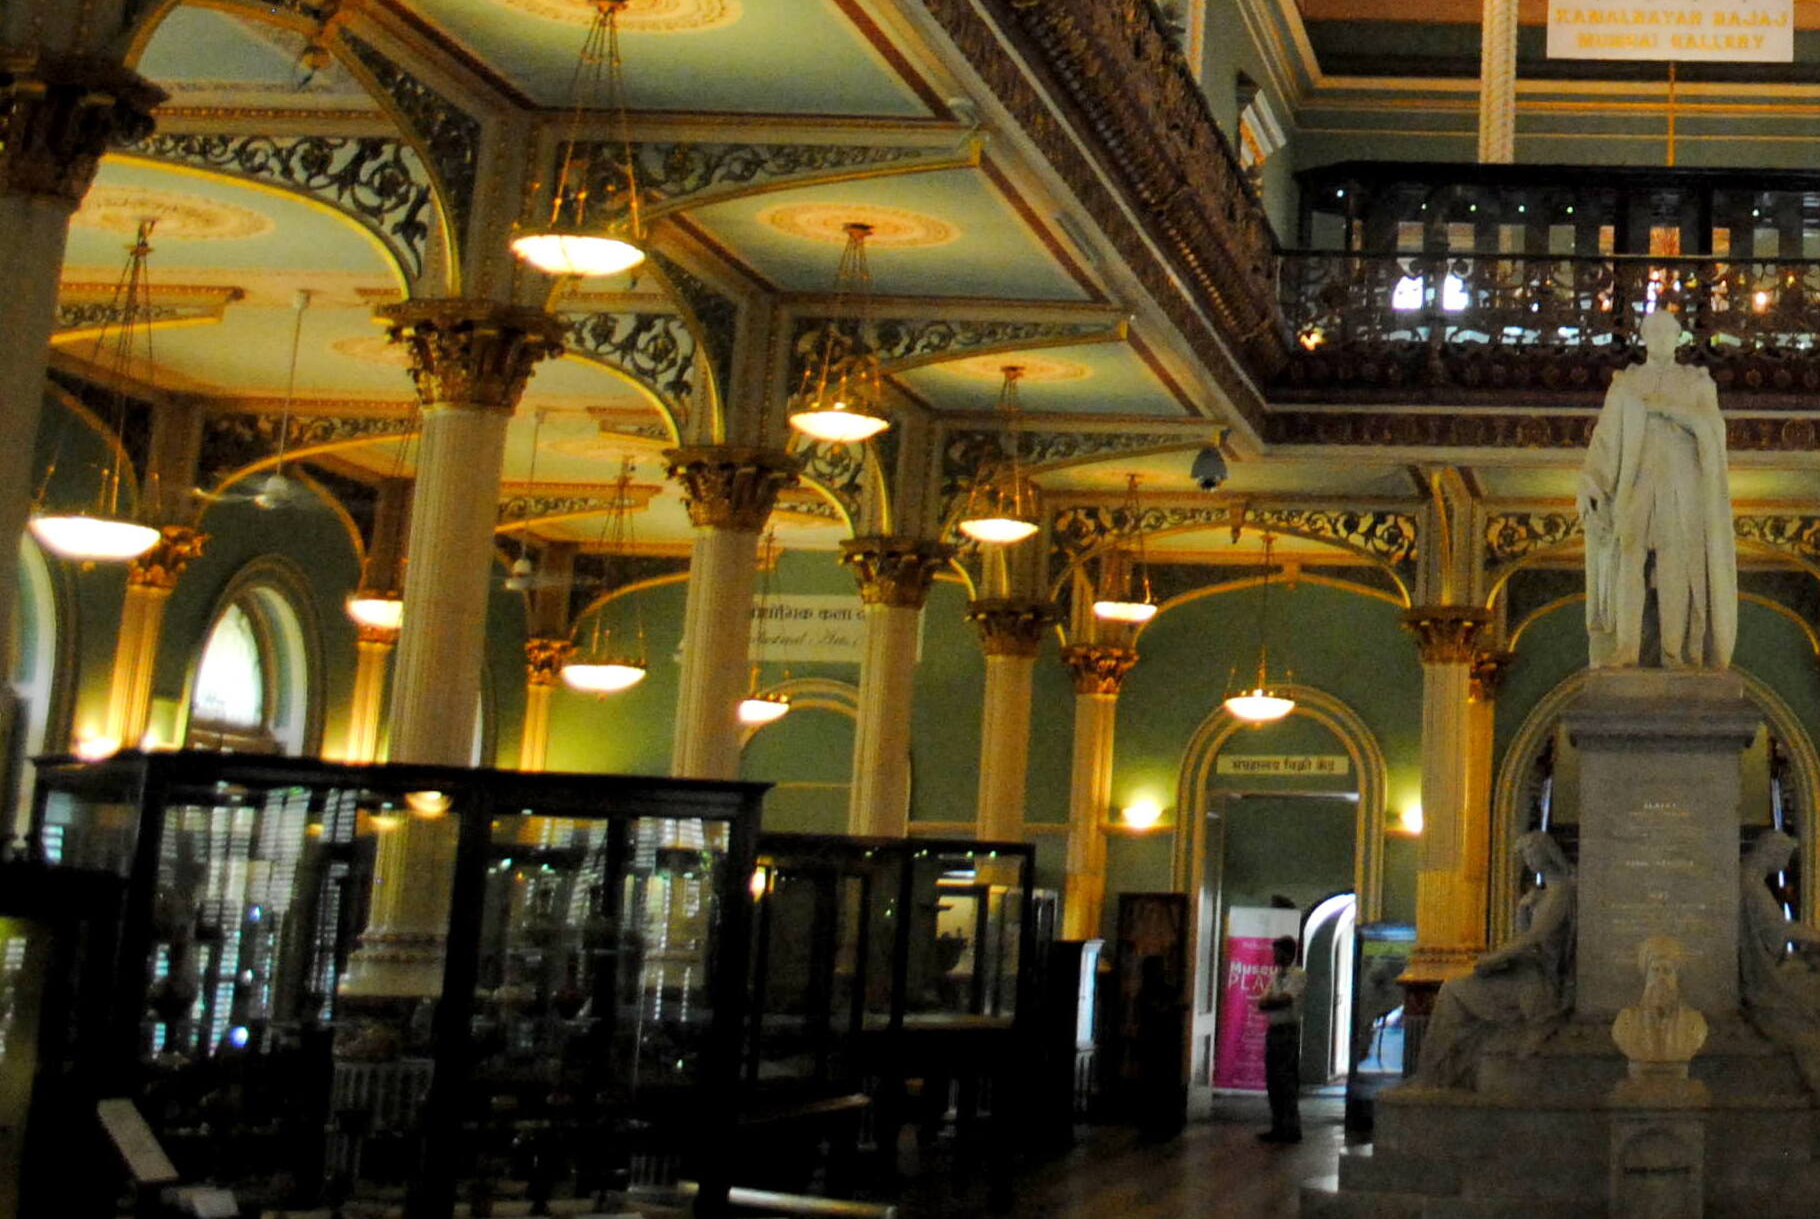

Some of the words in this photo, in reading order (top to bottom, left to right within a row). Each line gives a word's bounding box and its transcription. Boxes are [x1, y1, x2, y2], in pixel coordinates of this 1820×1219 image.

[1712, 10, 1788, 28] BAJAJ
[1670, 33, 1766, 51] GALLERY
[1229, 961, 1279, 975] Museu
